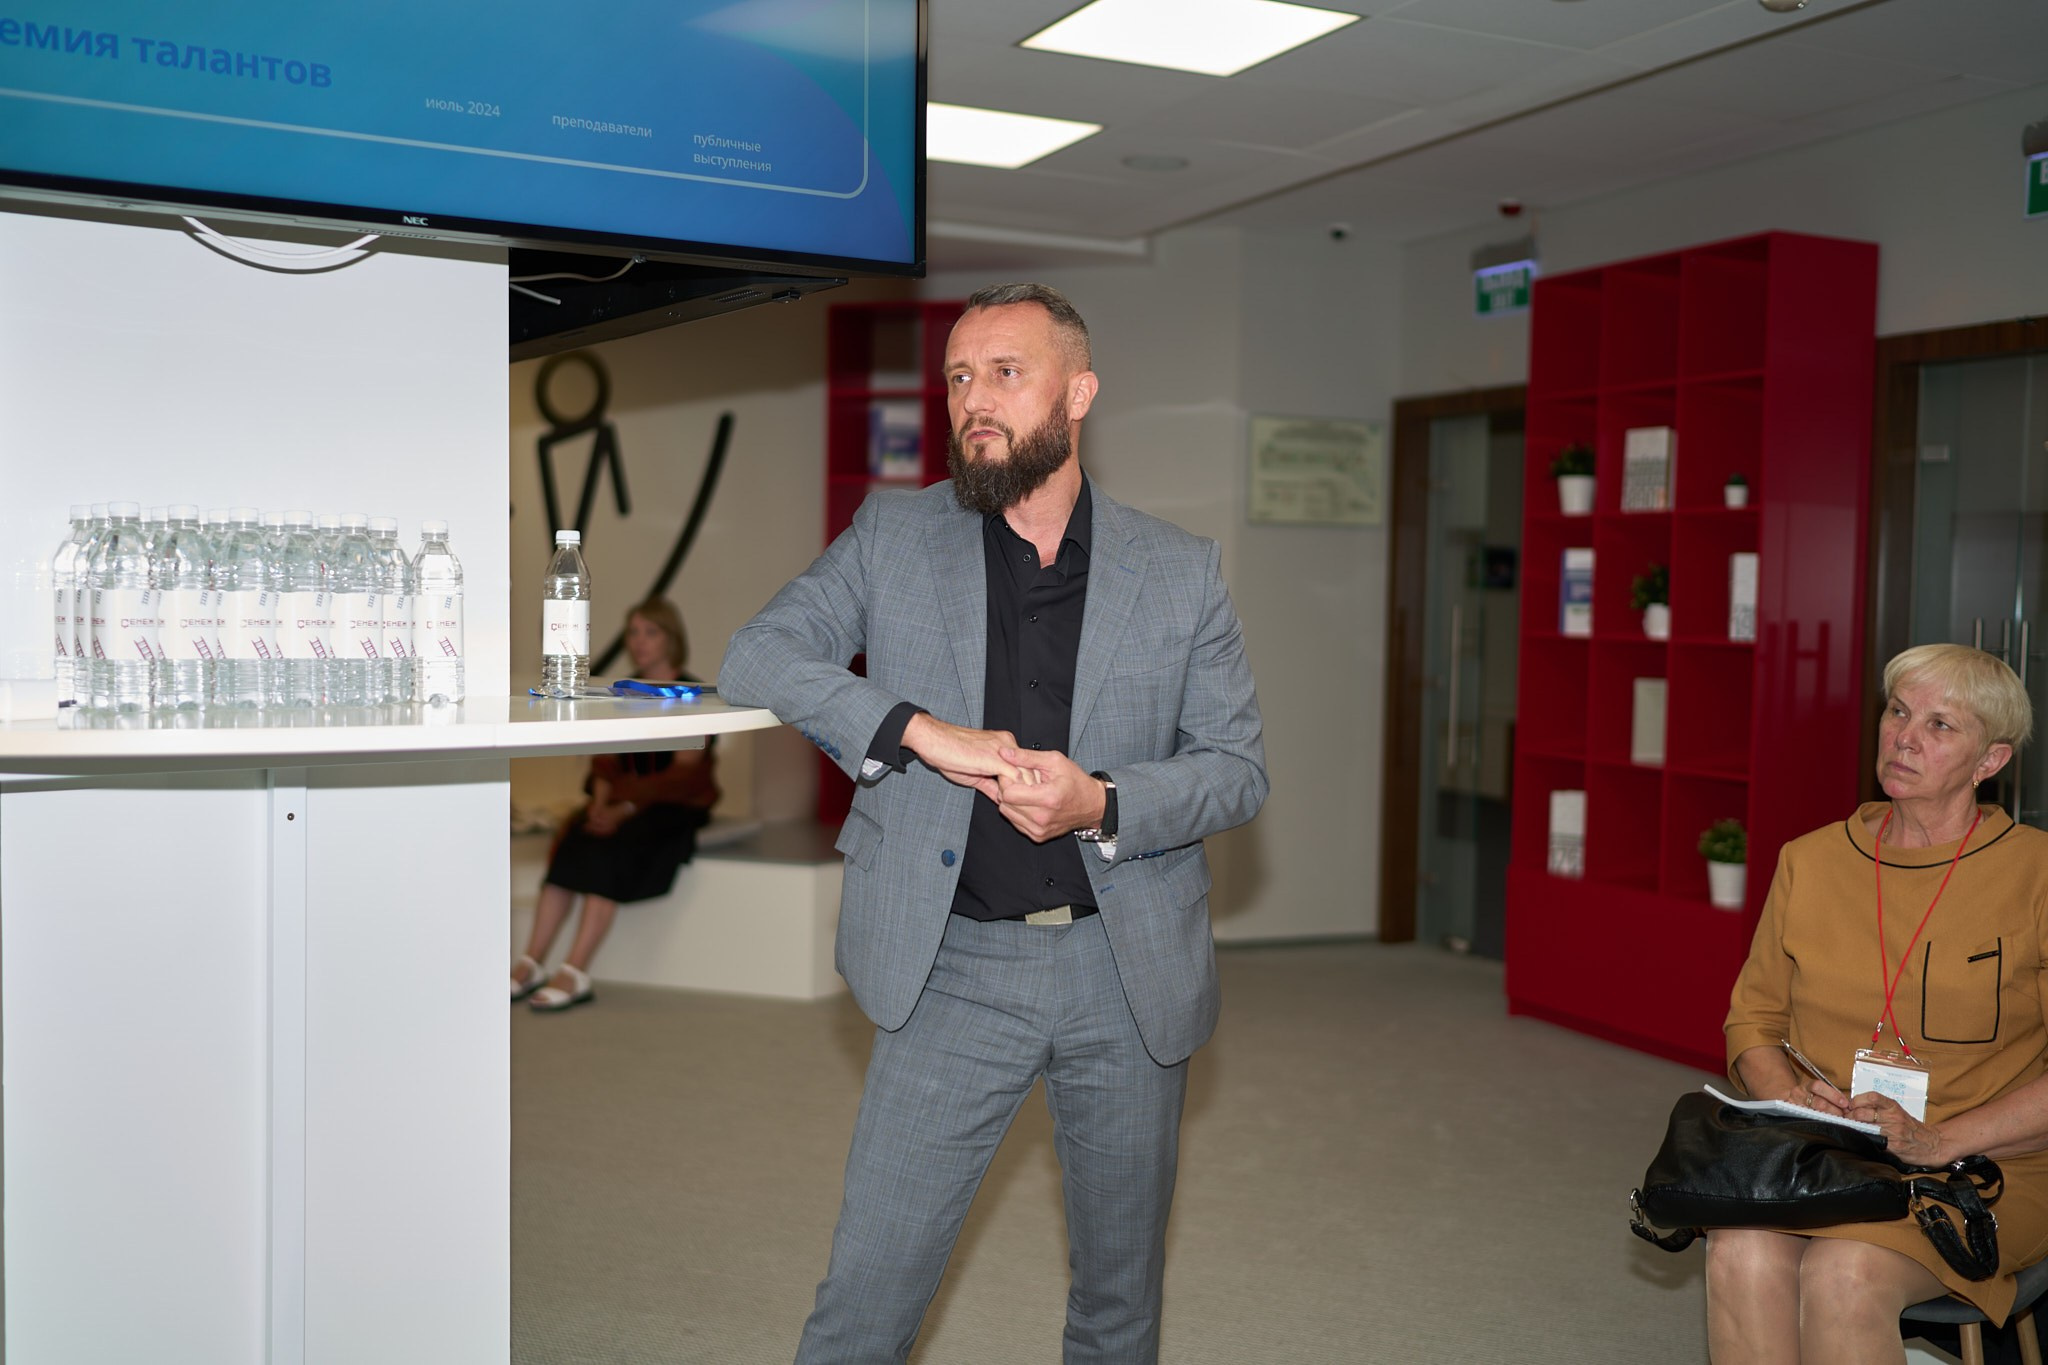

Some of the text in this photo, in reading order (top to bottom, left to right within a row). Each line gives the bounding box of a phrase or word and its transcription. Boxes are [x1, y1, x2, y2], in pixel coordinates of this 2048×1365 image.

[0, 17, 333, 88] емия талантов
[425, 98, 501, 117] июль 2024
[552, 115, 652, 138] преподаватели
[693, 134, 761, 152] публичные
[693, 153, 772, 172] выступления
[403, 215, 429, 226] NEC
